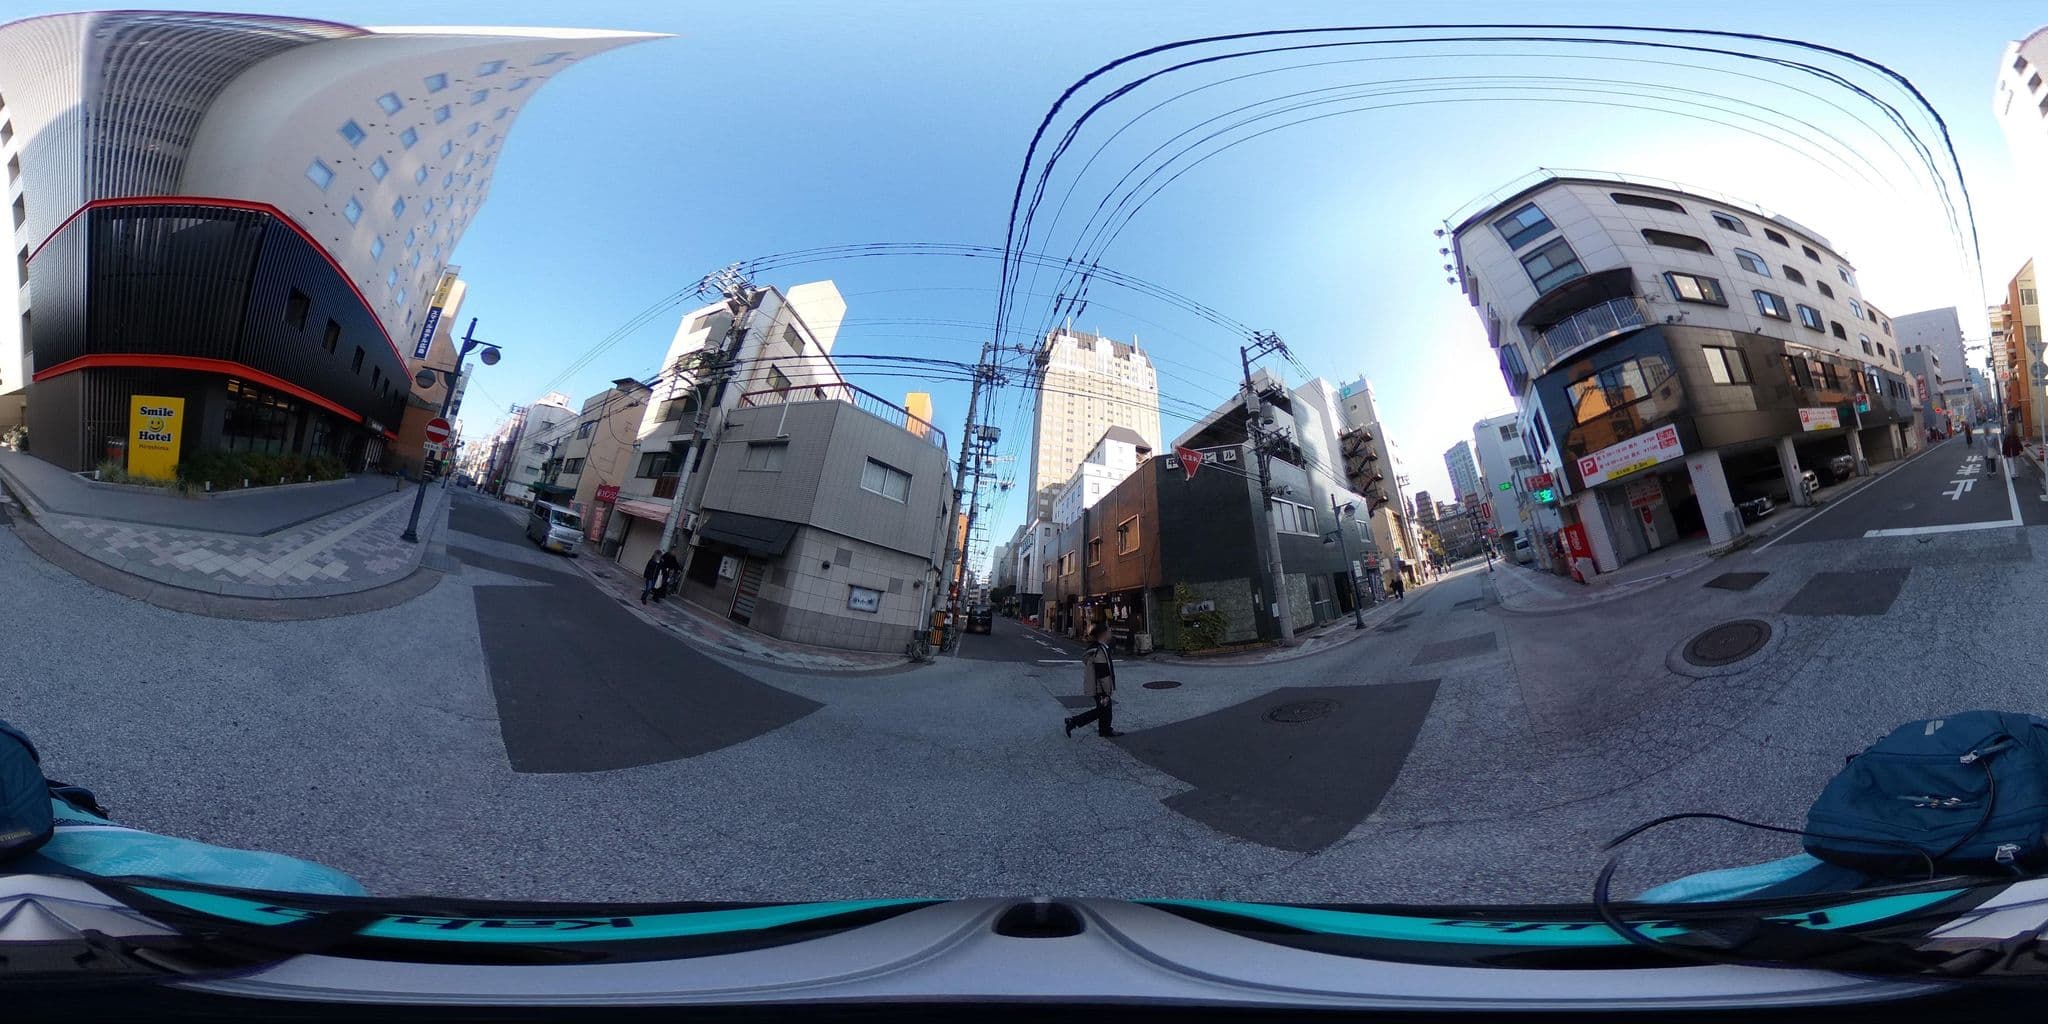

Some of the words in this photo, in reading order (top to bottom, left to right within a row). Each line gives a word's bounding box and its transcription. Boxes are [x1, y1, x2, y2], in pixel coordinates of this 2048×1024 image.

[140, 406, 174, 417] Smile
[138, 430, 172, 442] Hotel
[1183, 453, 1199, 463] 止まれ
[1581, 460, 1593, 474] P
[1942, 454, 1984, 500] 止まれ
